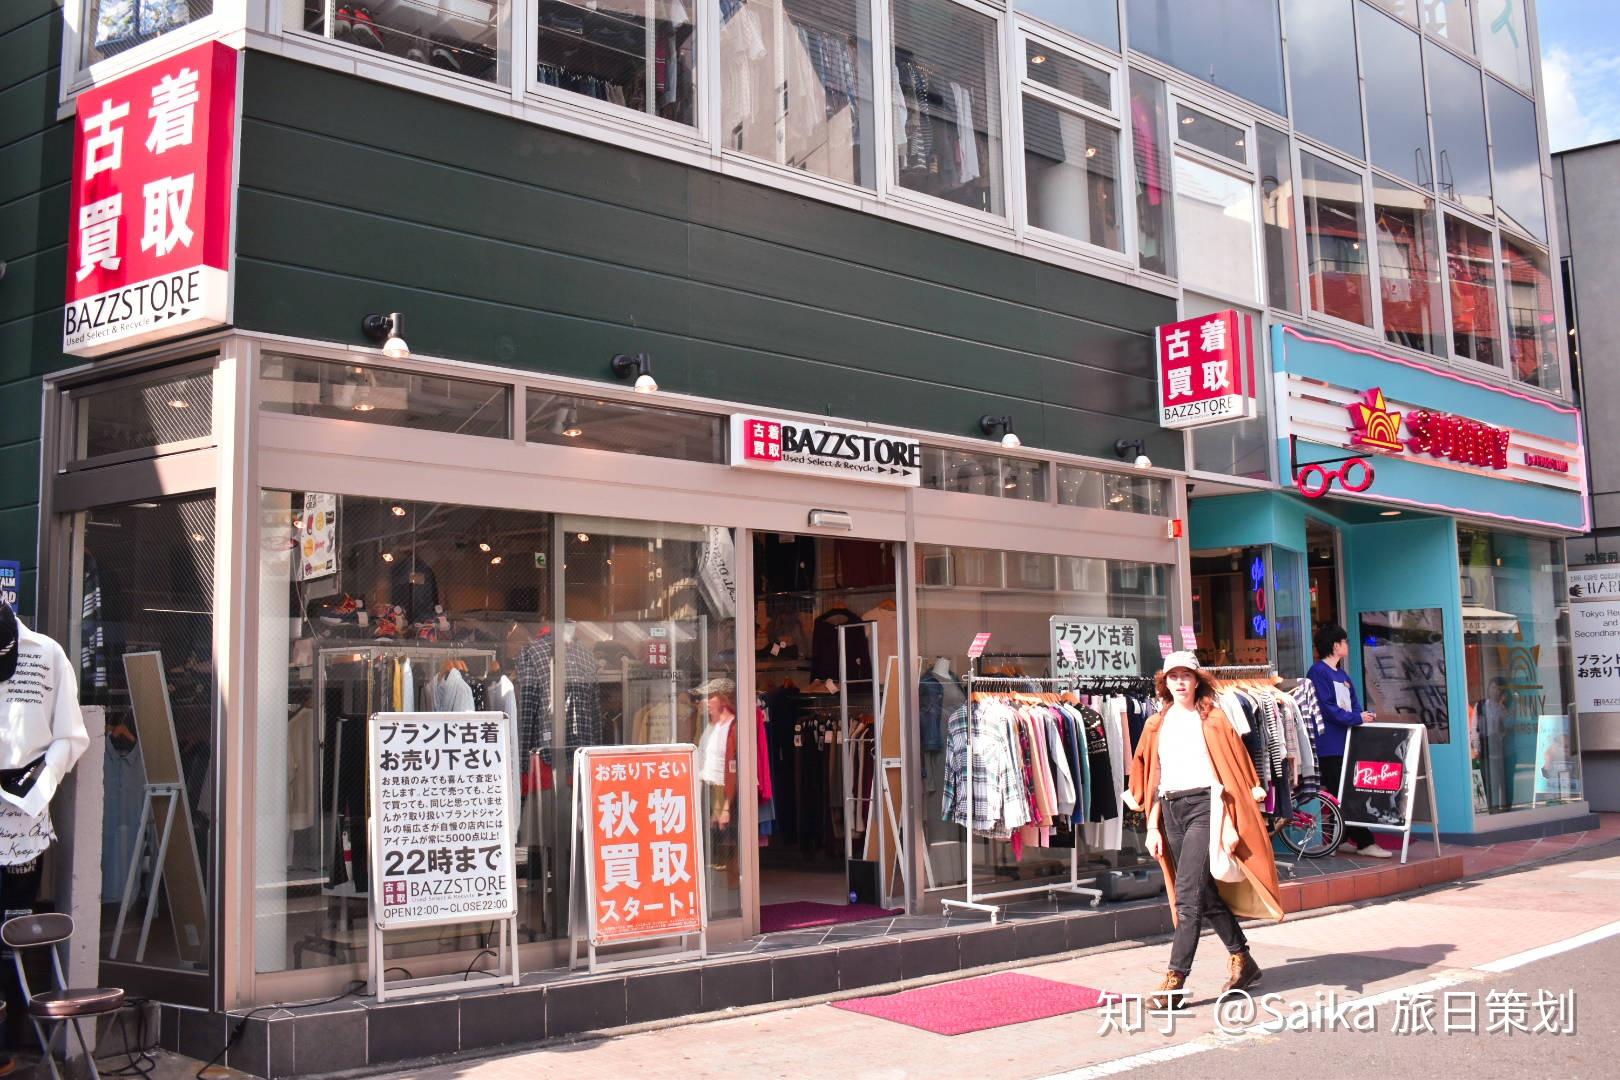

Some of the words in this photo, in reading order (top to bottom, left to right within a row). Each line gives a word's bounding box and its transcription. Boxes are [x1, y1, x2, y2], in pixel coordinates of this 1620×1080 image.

[83, 67, 199, 180] 古着
[76, 172, 195, 282] 買取
[65, 270, 200, 336] BAZZSTORE
[66, 334, 85, 346] Used
[87, 328, 109, 341] Select
[111, 326, 118, 334] &
[120, 318, 150, 331] Recycle
[1166, 320, 1226, 360] 古着
[1168, 360, 1230, 400] 買取
[1164, 396, 1233, 420] BAZZSTORE
[753, 423, 779, 440] 古着
[753, 440, 780, 457] 買取
[783, 425, 922, 468] BAZZSTORE
[783, 453, 805, 464] Used
[807, 457, 832, 467] Select
[843, 462, 875, 472] Recycle
[1580, 610, 1605, 618] Tokyo
[1603, 619, 1618, 627] and
[1056, 619, 1134, 646] ブランド古着
[1056, 649, 1136, 671] お売り下さい
[380, 722, 499, 744] ブランド古着
[380, 748, 502, 771] お売り下さい
[382, 774, 501, 786] お見積のみでも喜んで査定い
[595, 761, 687, 782] お売り下さい
[1353, 762, 1399, 786] Ray-Ban
[384, 808, 502, 822] んか?取り扱いブランドジャン
[598, 788, 686, 839] 秋物
[384, 820, 502, 833] ルの幅広さが自慢の店内には
[384, 832, 499, 846] アイテムが常に5000点以上!
[385, 844, 502, 876] 22時まで
[601, 840, 692, 893] 買取
[385, 881, 406, 892] 古着
[411, 875, 507, 896] BAZZSTORE
[600, 892, 695, 924] スタート!
